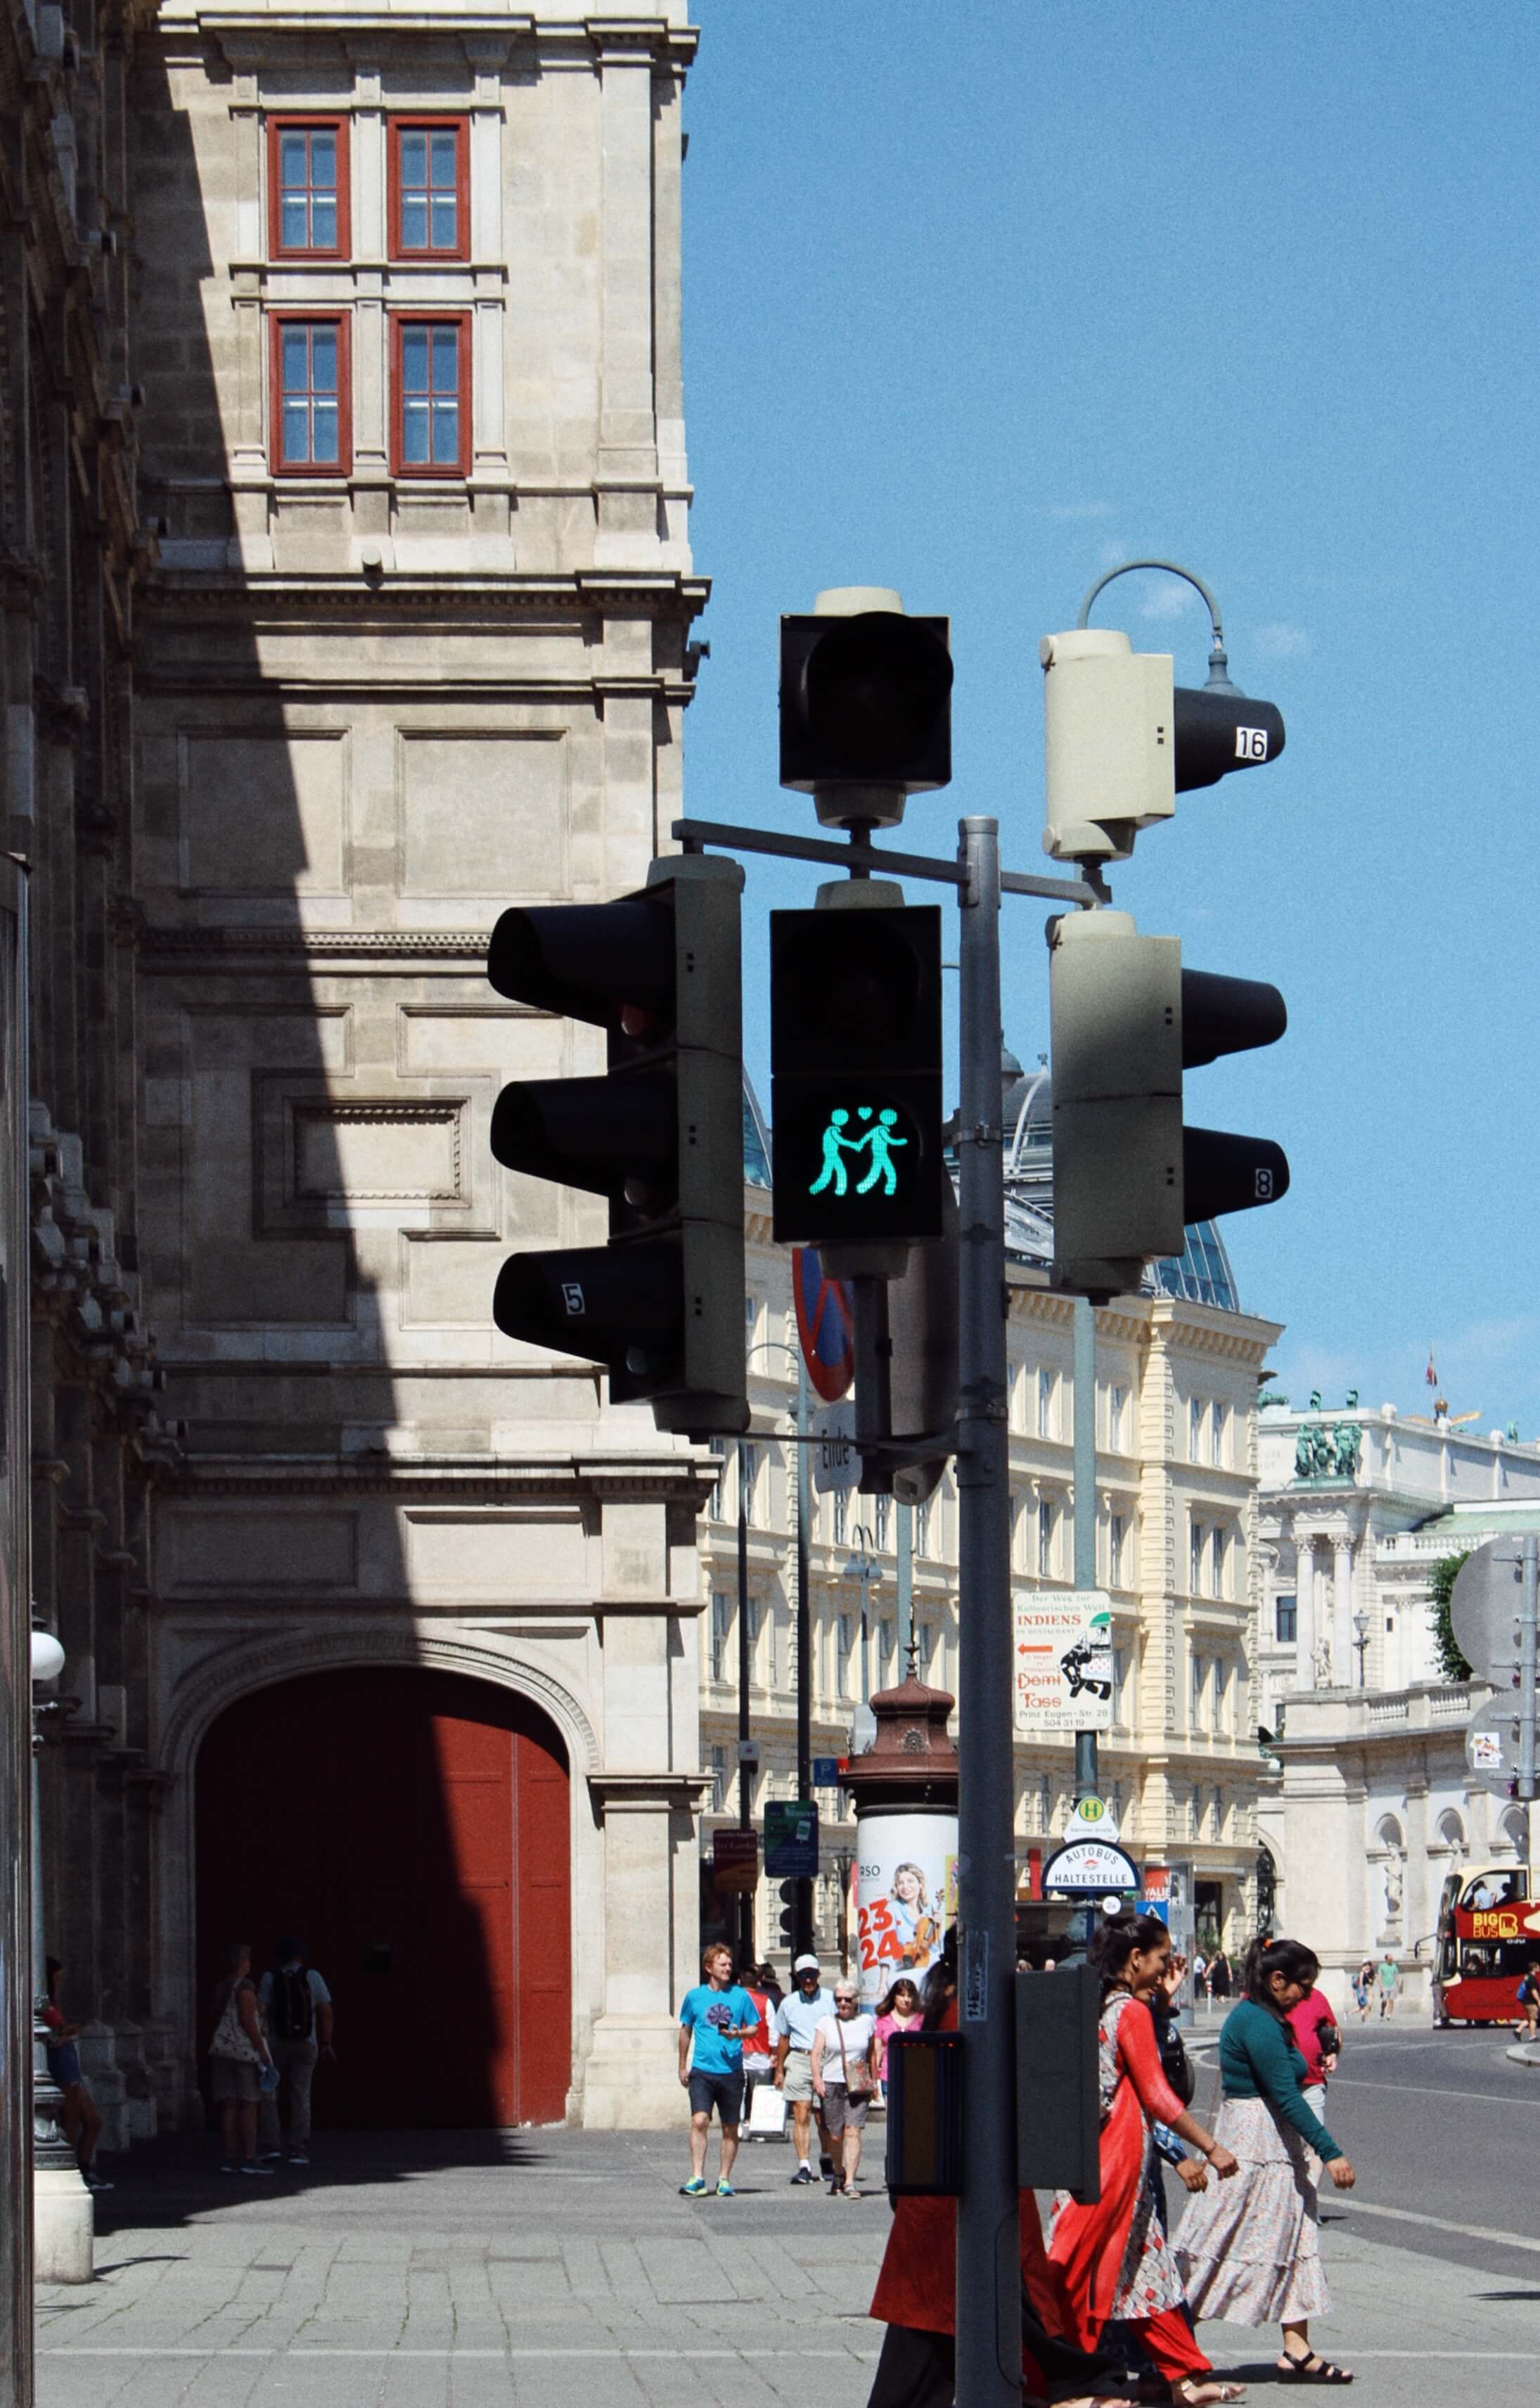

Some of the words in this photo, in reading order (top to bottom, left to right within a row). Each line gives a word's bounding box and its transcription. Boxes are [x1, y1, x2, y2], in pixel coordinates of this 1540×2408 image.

[1240, 730, 1265, 757] 16
[1257, 1170, 1271, 1196] 8
[564, 1286, 583, 1312] 5
[821, 1426, 849, 1470] Ende
[1018, 1615, 1082, 1626] INDIENS
[1018, 1673, 1061, 1689] Demi
[1020, 1693, 1062, 1709] Tass
[1085, 1802, 1098, 1818] H
[1065, 1846, 1119, 1865] AUTOBUS
[860, 1865, 880, 1877] RSO
[1055, 1874, 1127, 1884] HALTESTELLE
[1473, 1912, 1499, 1926] BIG
[1473, 1926, 1499, 1938] BUS
[860, 1930, 904, 1971] 24
